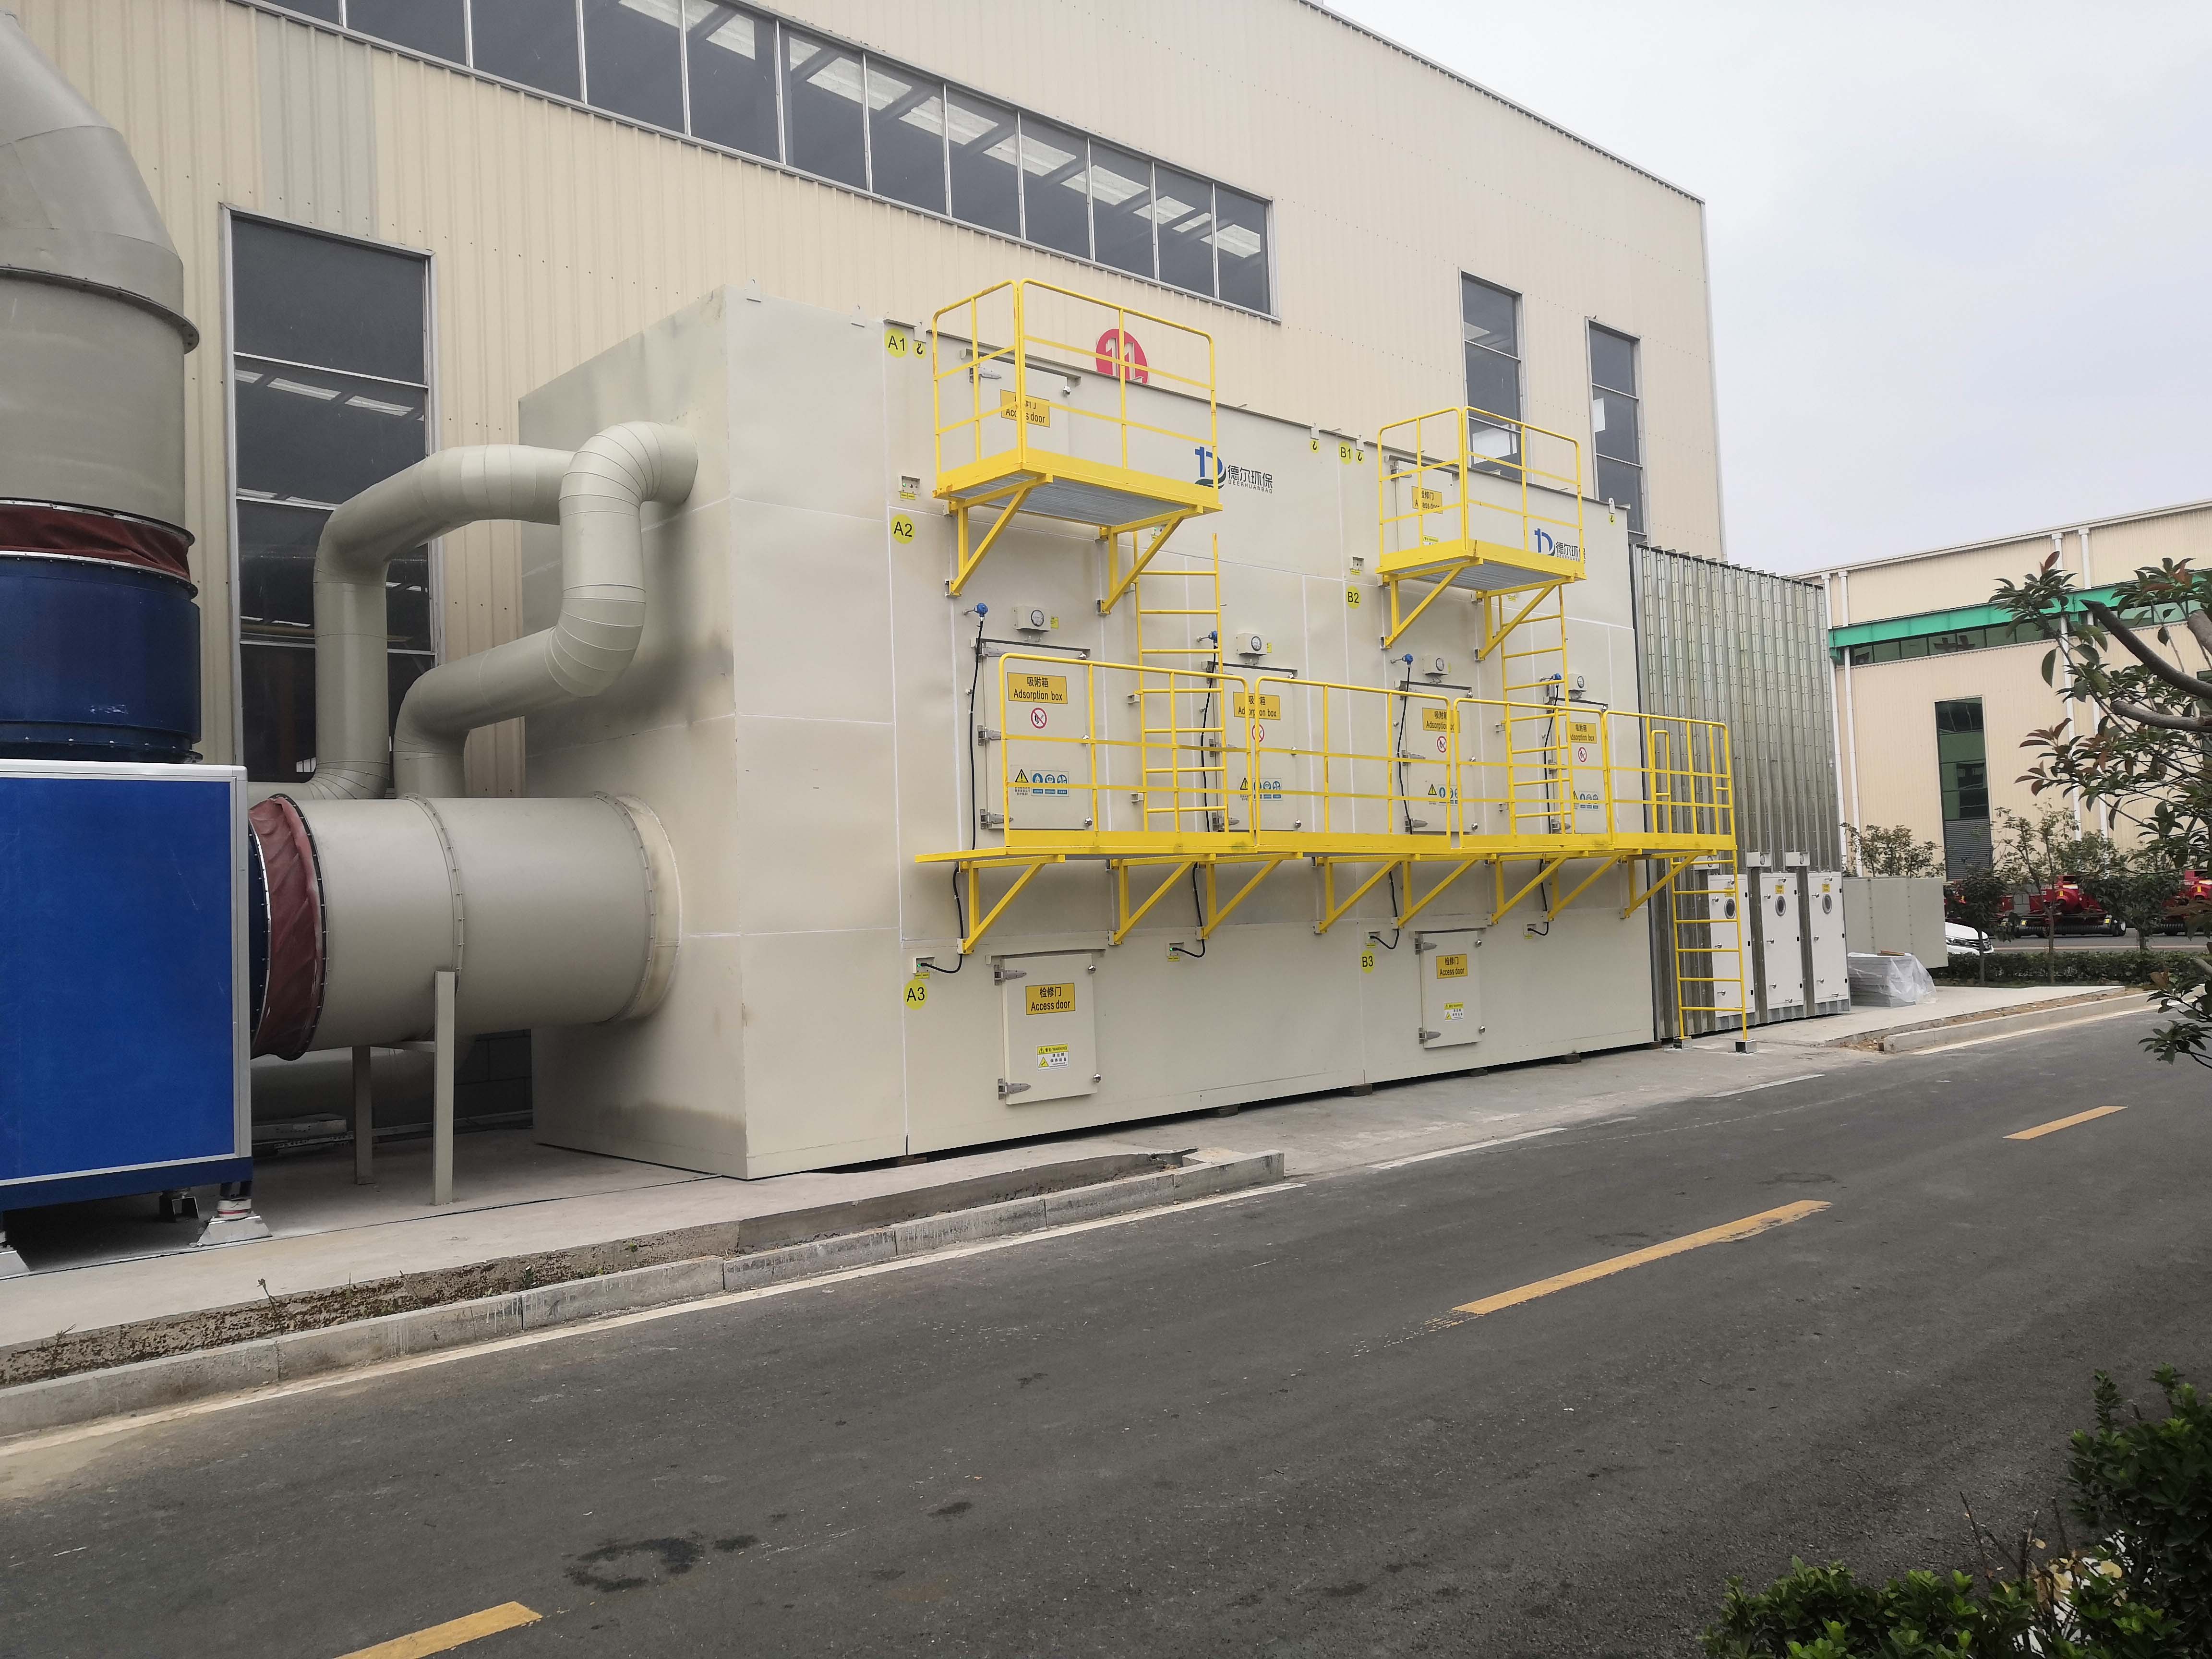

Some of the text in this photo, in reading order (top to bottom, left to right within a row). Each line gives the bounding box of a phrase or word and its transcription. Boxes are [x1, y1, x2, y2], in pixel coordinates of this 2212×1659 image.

[888, 335, 904, 351] A1
[1005, 409, 1045, 423] Accs door
[1340, 446, 1351, 459] B1
[1227, 464, 1273, 489] 德尔环保
[893, 521, 913, 537] A2
[1347, 591, 1359, 603] B2
[1027, 677, 1049, 687] 吸附箱
[1014, 688, 1063, 701] Adsorption box
[1249, 695, 1266, 705] 吸箱
[1267, 708, 1277, 717] box
[1362, 956, 1373, 967] B3
[906, 987, 925, 1002] A3
[1040, 986, 1061, 998] 检修门
[1031, 999, 1070, 1011] Access door
